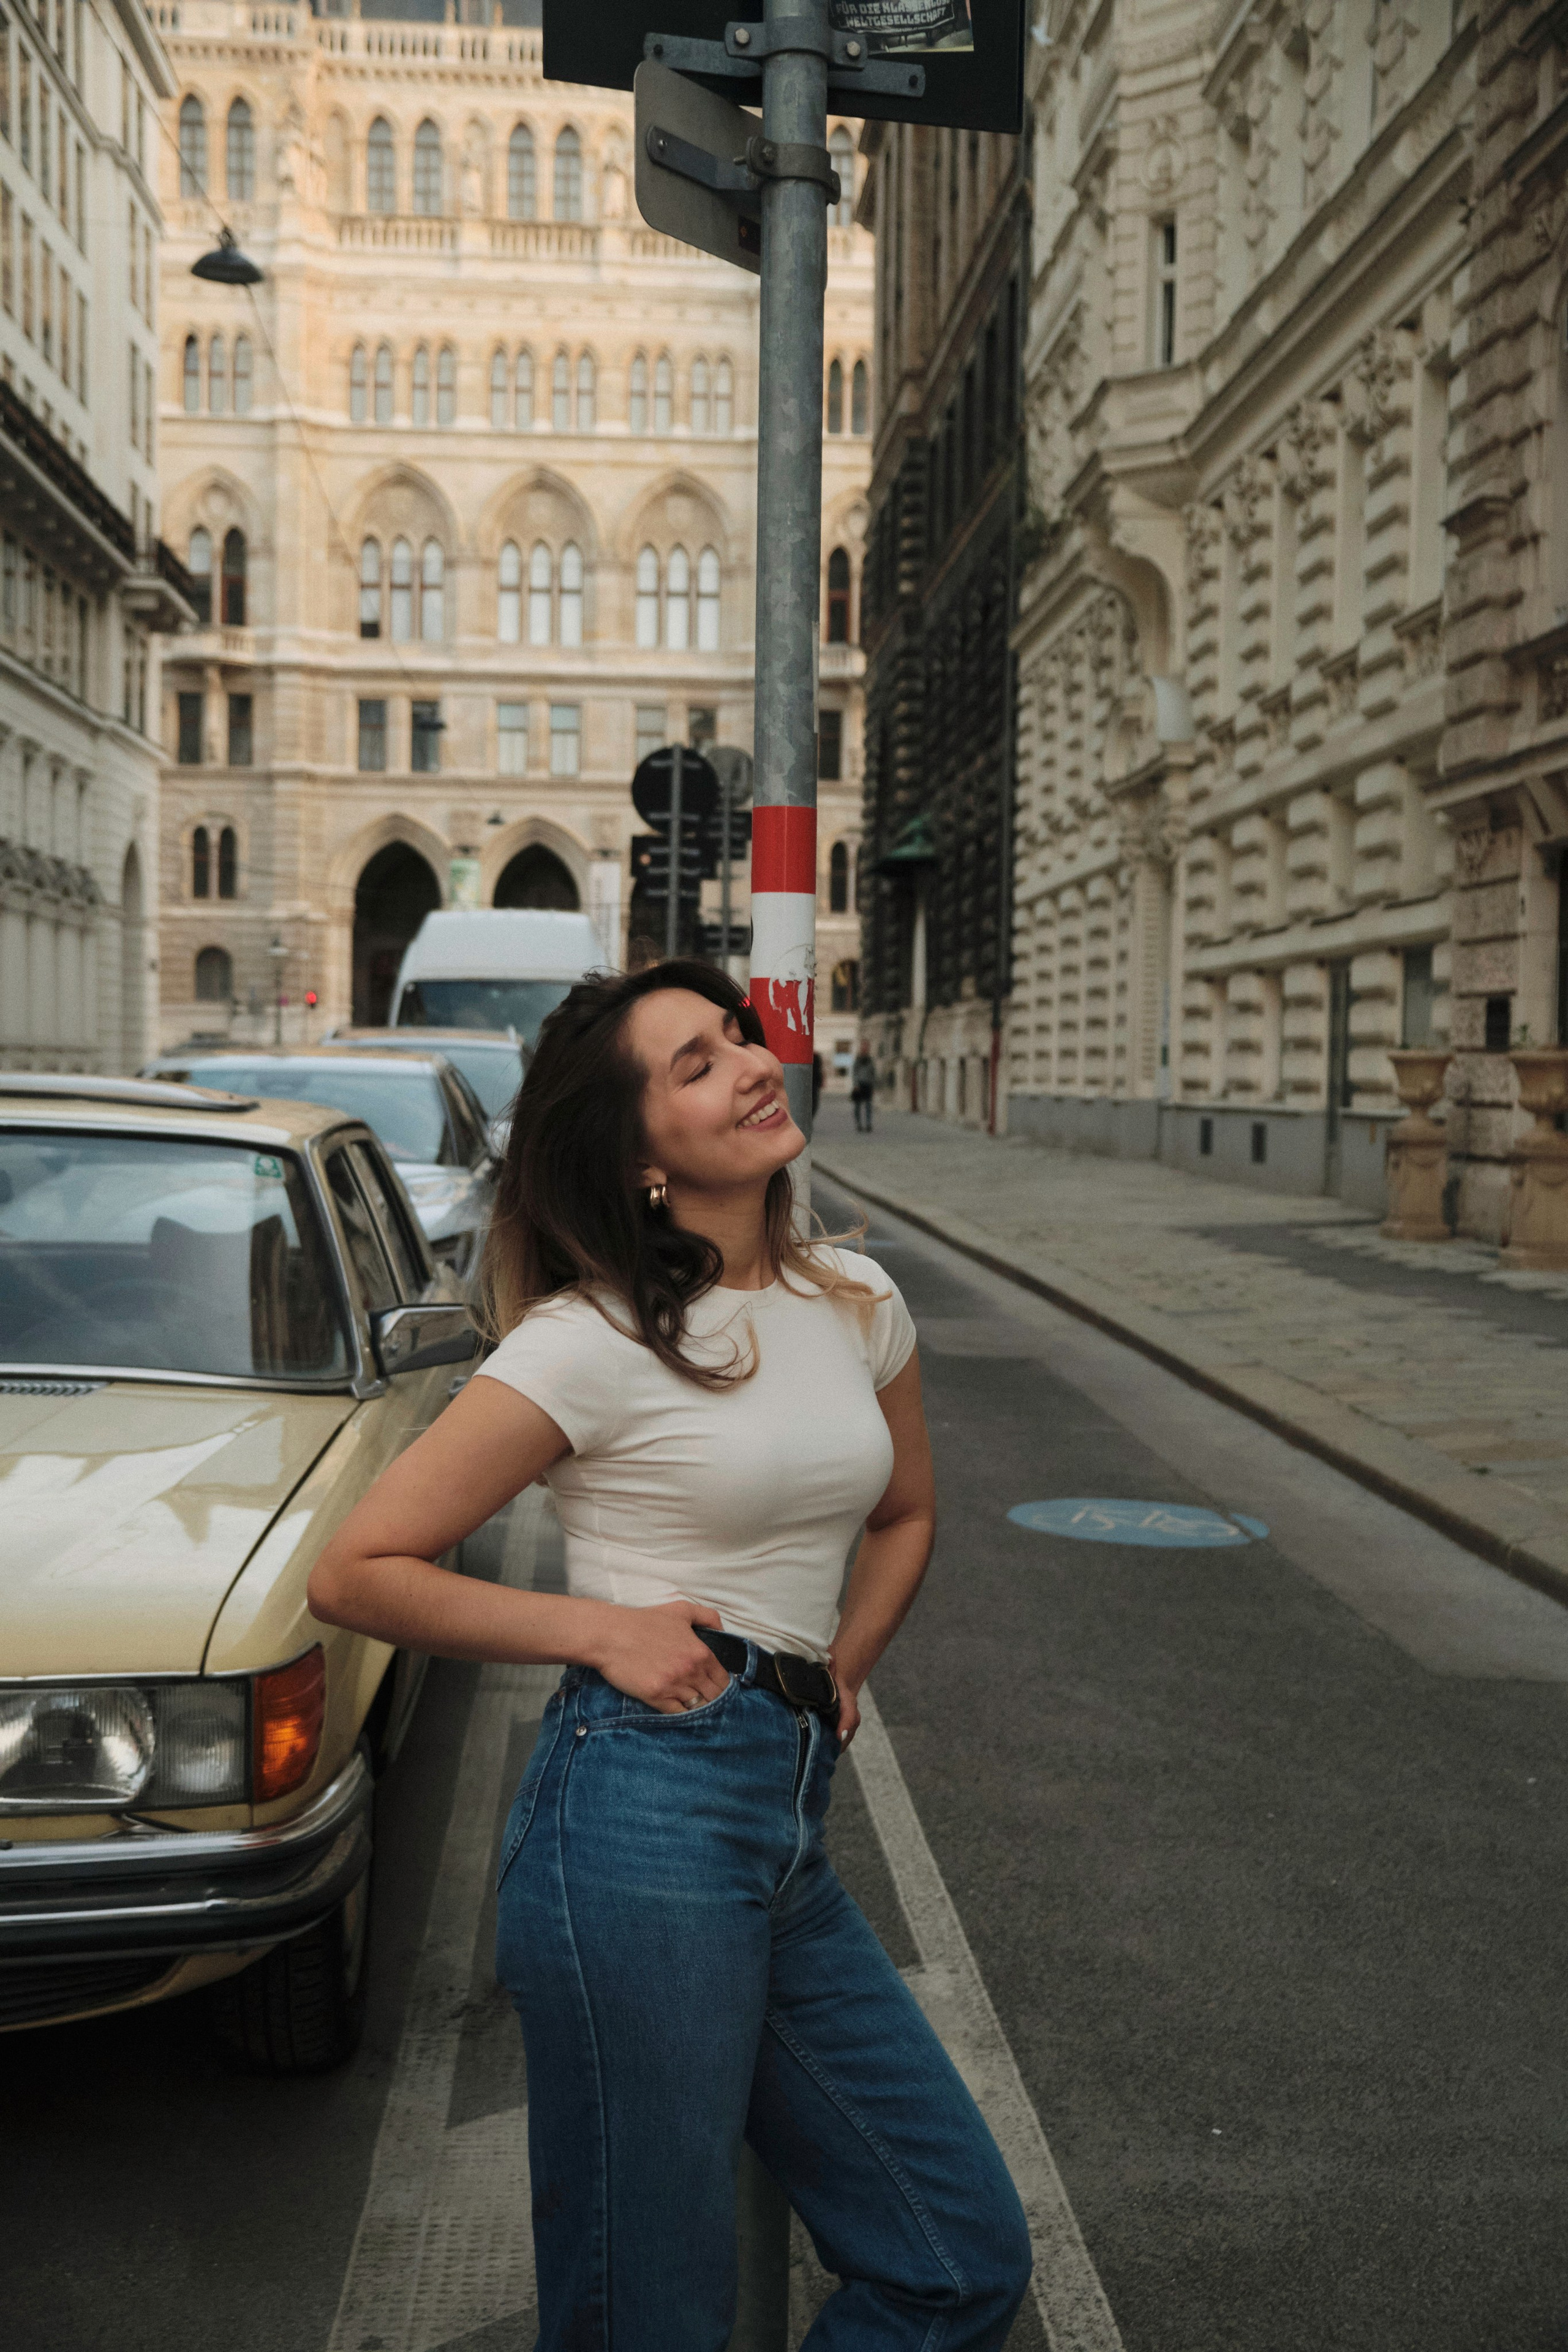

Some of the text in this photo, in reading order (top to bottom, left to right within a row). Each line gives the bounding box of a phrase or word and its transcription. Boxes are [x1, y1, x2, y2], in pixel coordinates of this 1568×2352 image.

[835, 1, 858, 14] FÜR
[859, 3, 881, 13] DIE
[846, 7, 946, 27] WELTGESELLSCHAFT
